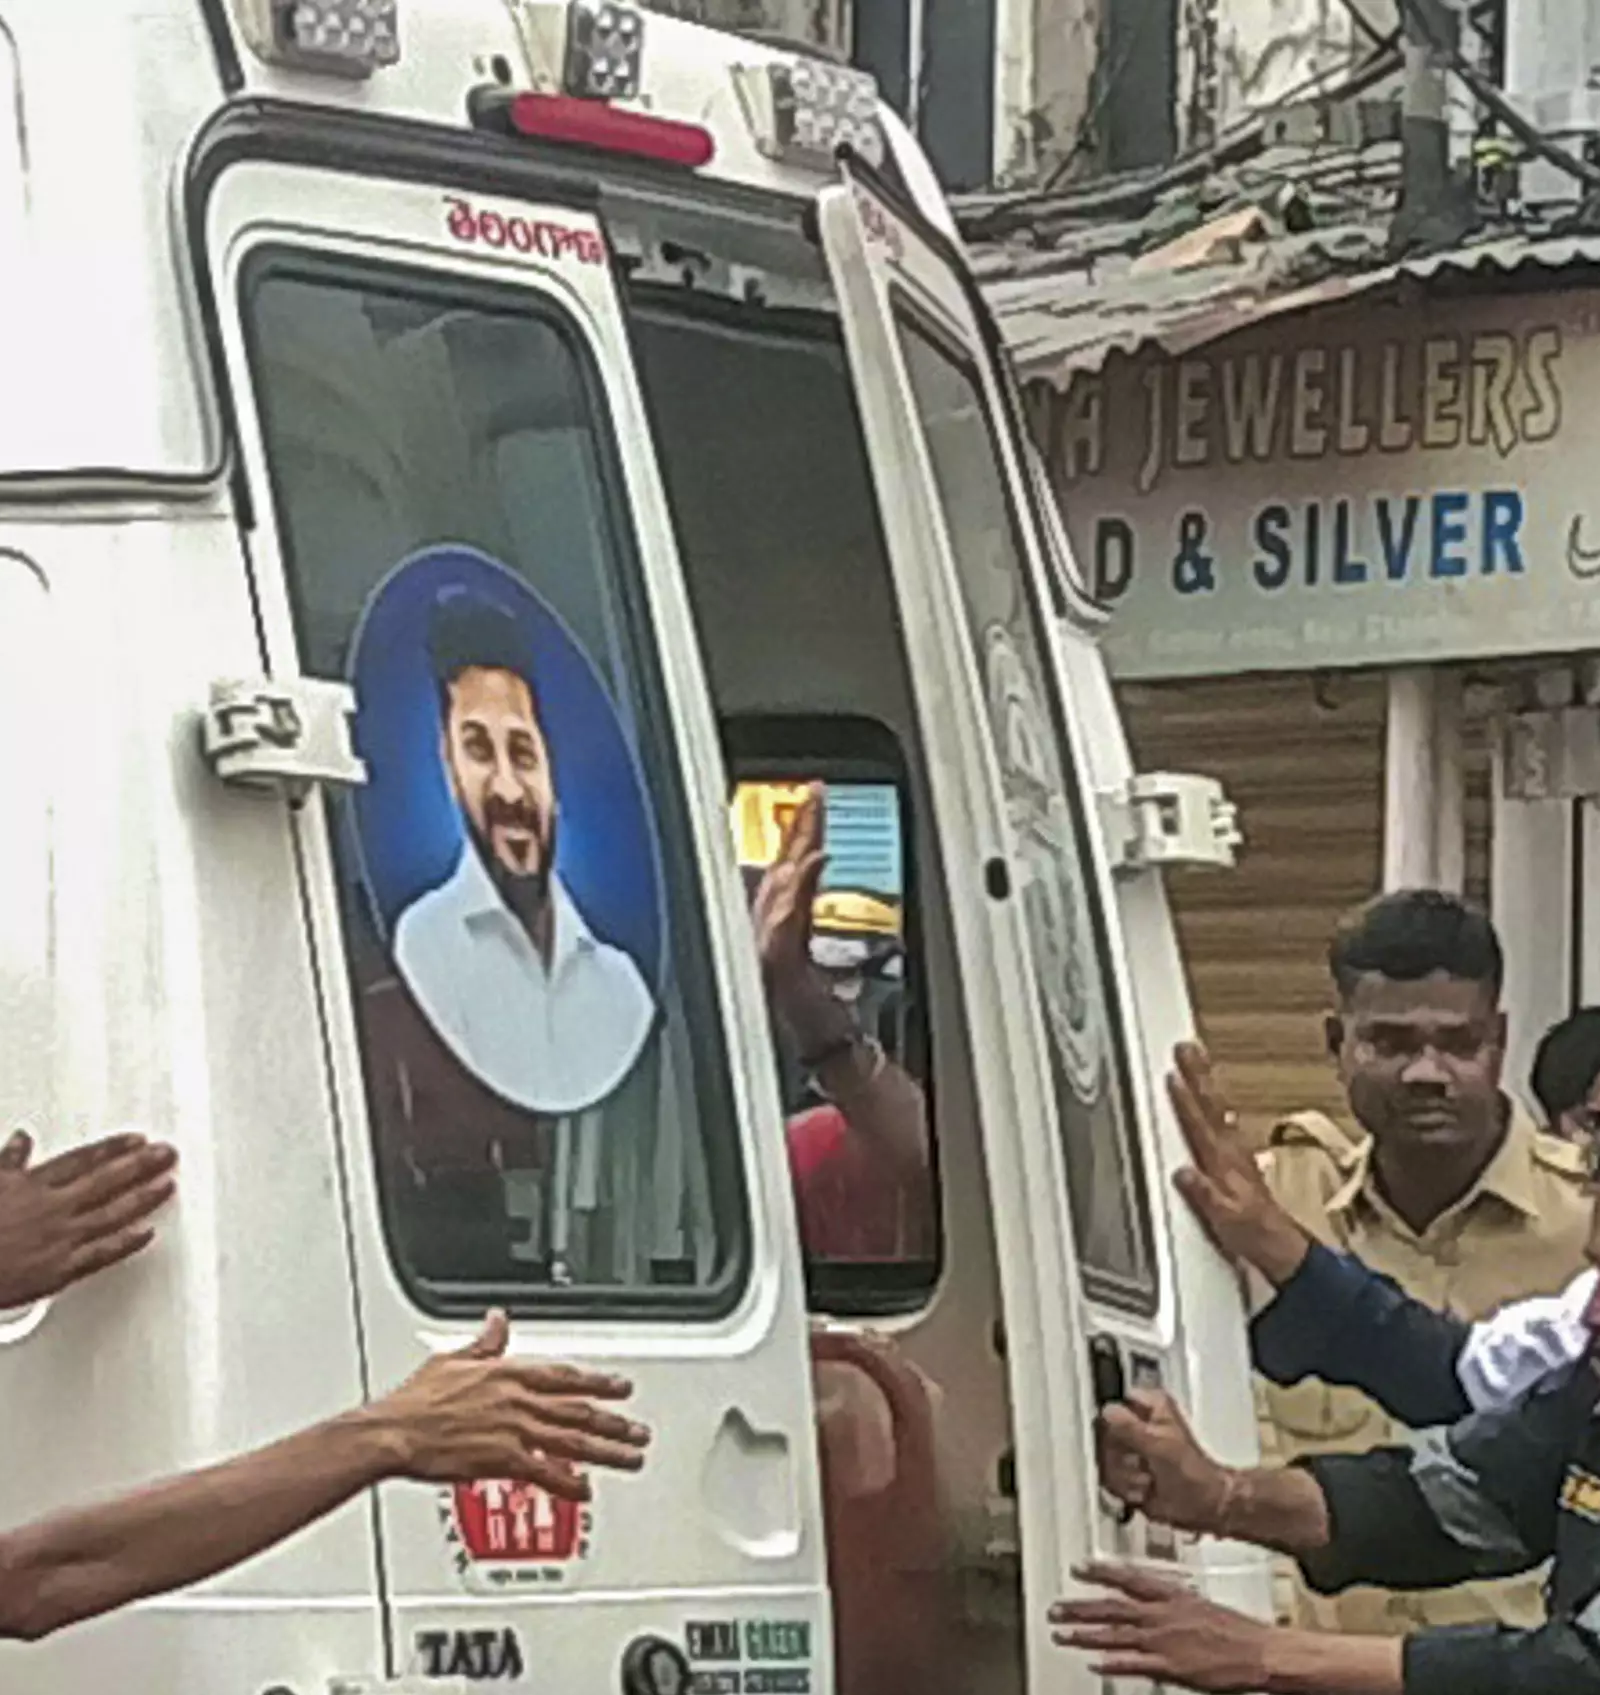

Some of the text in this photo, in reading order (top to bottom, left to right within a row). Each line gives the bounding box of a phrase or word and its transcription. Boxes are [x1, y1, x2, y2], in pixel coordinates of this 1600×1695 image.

[1136, 326, 1565, 494] JEWELLERS
[1095, 490, 1526, 601] D & SILVER
[416, 1628, 524, 1681] TATA
